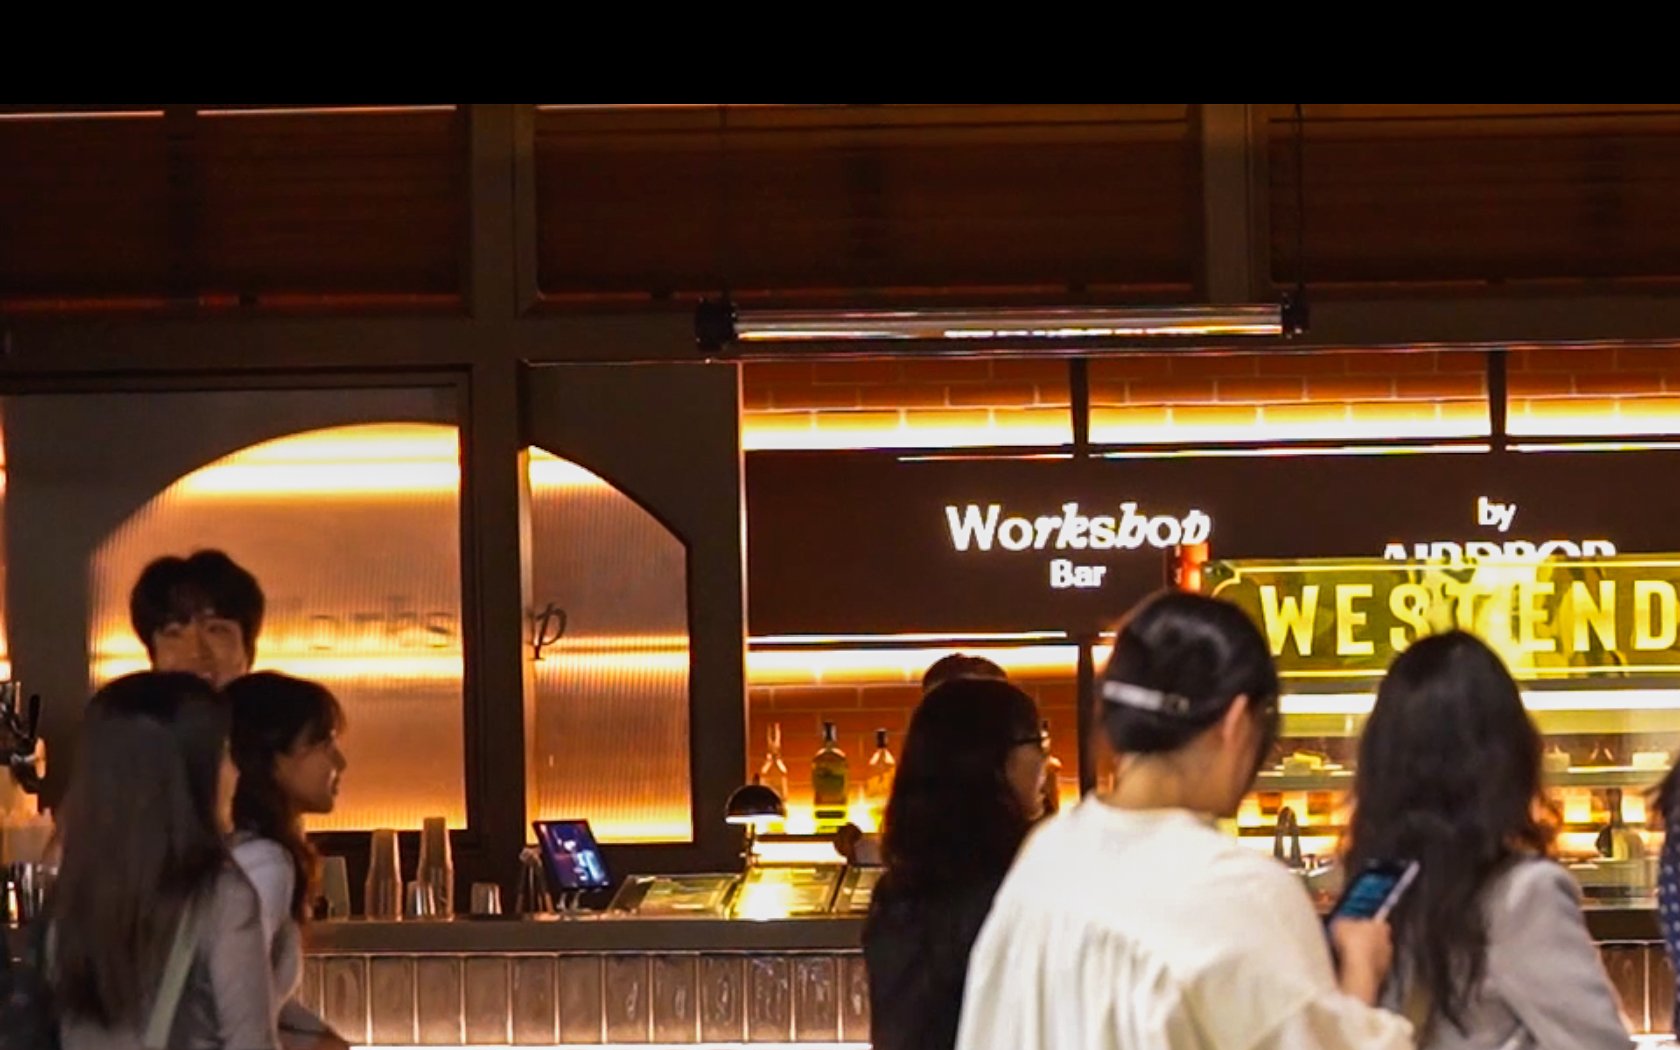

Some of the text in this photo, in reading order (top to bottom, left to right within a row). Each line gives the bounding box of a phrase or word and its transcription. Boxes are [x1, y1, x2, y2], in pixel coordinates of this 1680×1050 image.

[945, 503, 1211, 551] Workshop
[1476, 496, 1516, 532] by
[1050, 559, 1106, 588] Bar
